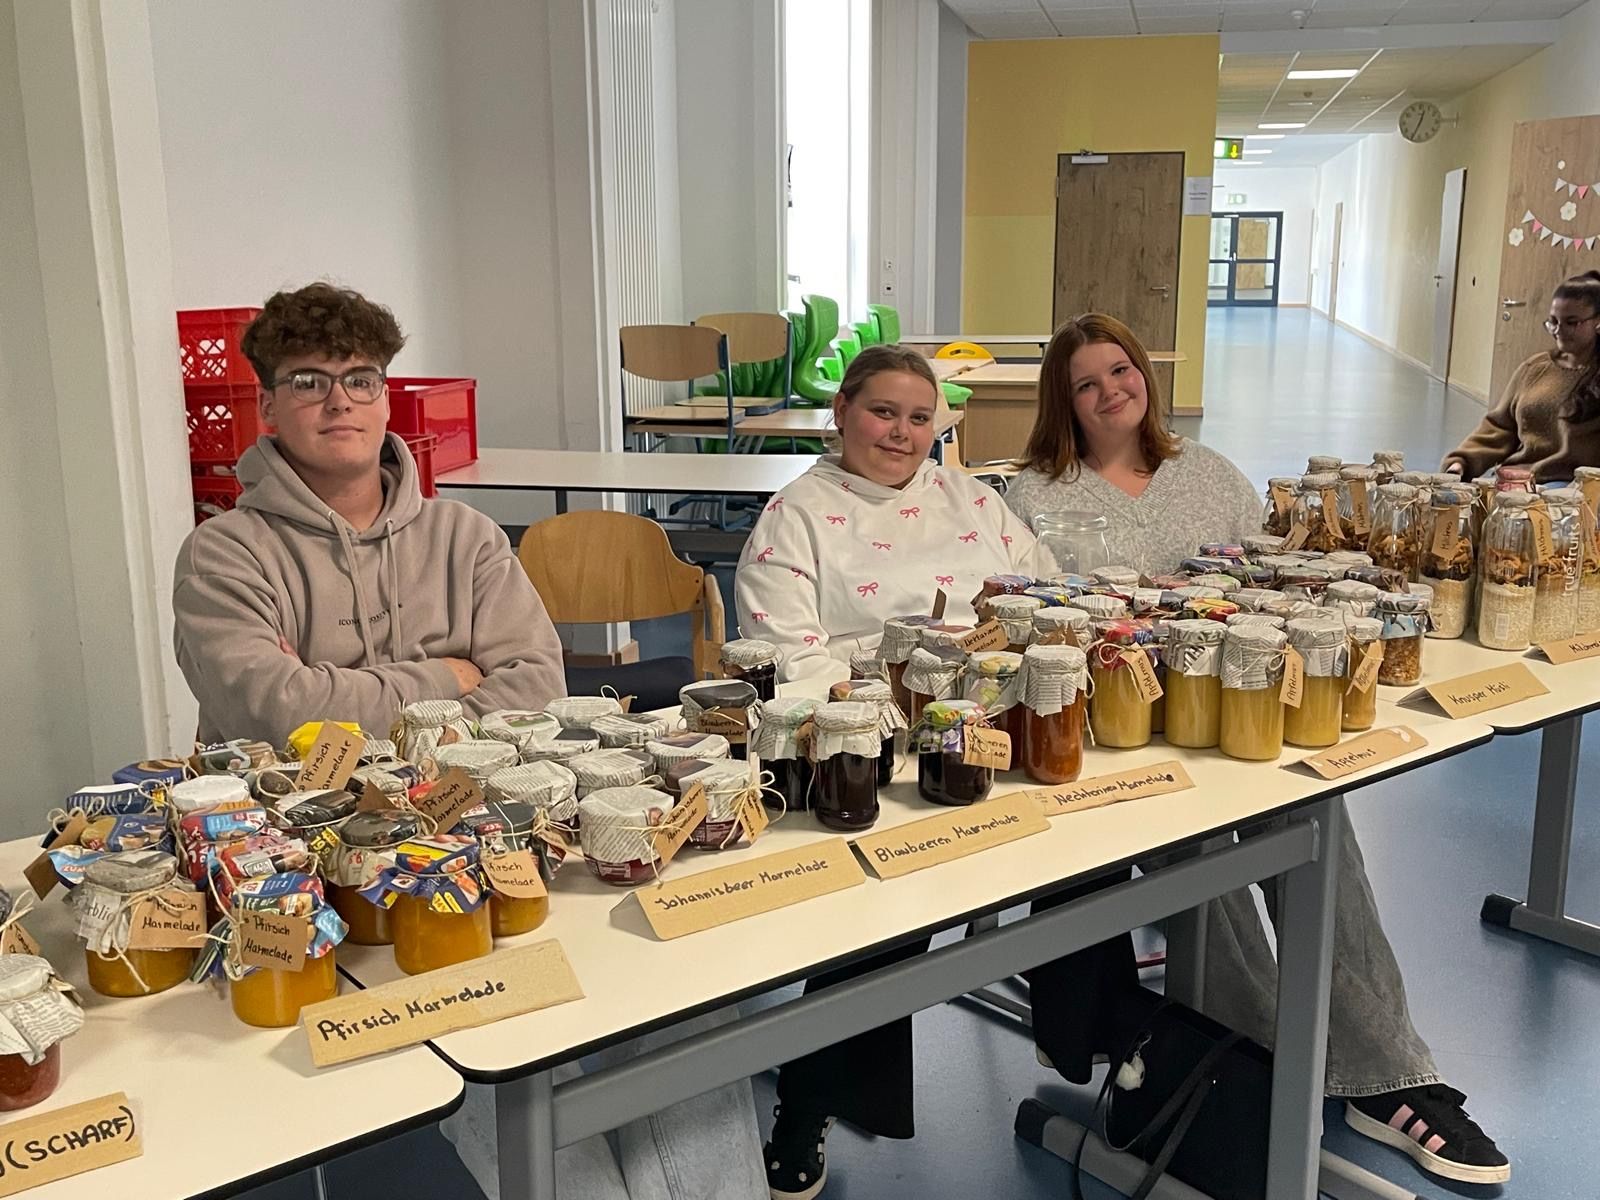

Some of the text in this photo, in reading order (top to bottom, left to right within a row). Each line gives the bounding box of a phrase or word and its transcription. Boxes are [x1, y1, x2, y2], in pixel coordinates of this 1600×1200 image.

[1562, 521, 1580, 596] true fruits
[301, 742, 331, 782] Pfirsich
[318, 740, 352, 790] armelade
[422, 782, 461, 810] Pfirsich
[654, 859, 829, 911] Johannisbeer Marmelade
[142, 915, 201, 932] Marmelade
[253, 914, 290, 936] Pfirsich
[244, 937, 293, 963] Marmelade
[316, 979, 506, 1042] Pfirsich Marmelade
[5, 1105, 135, 1170] (SCHARF)
